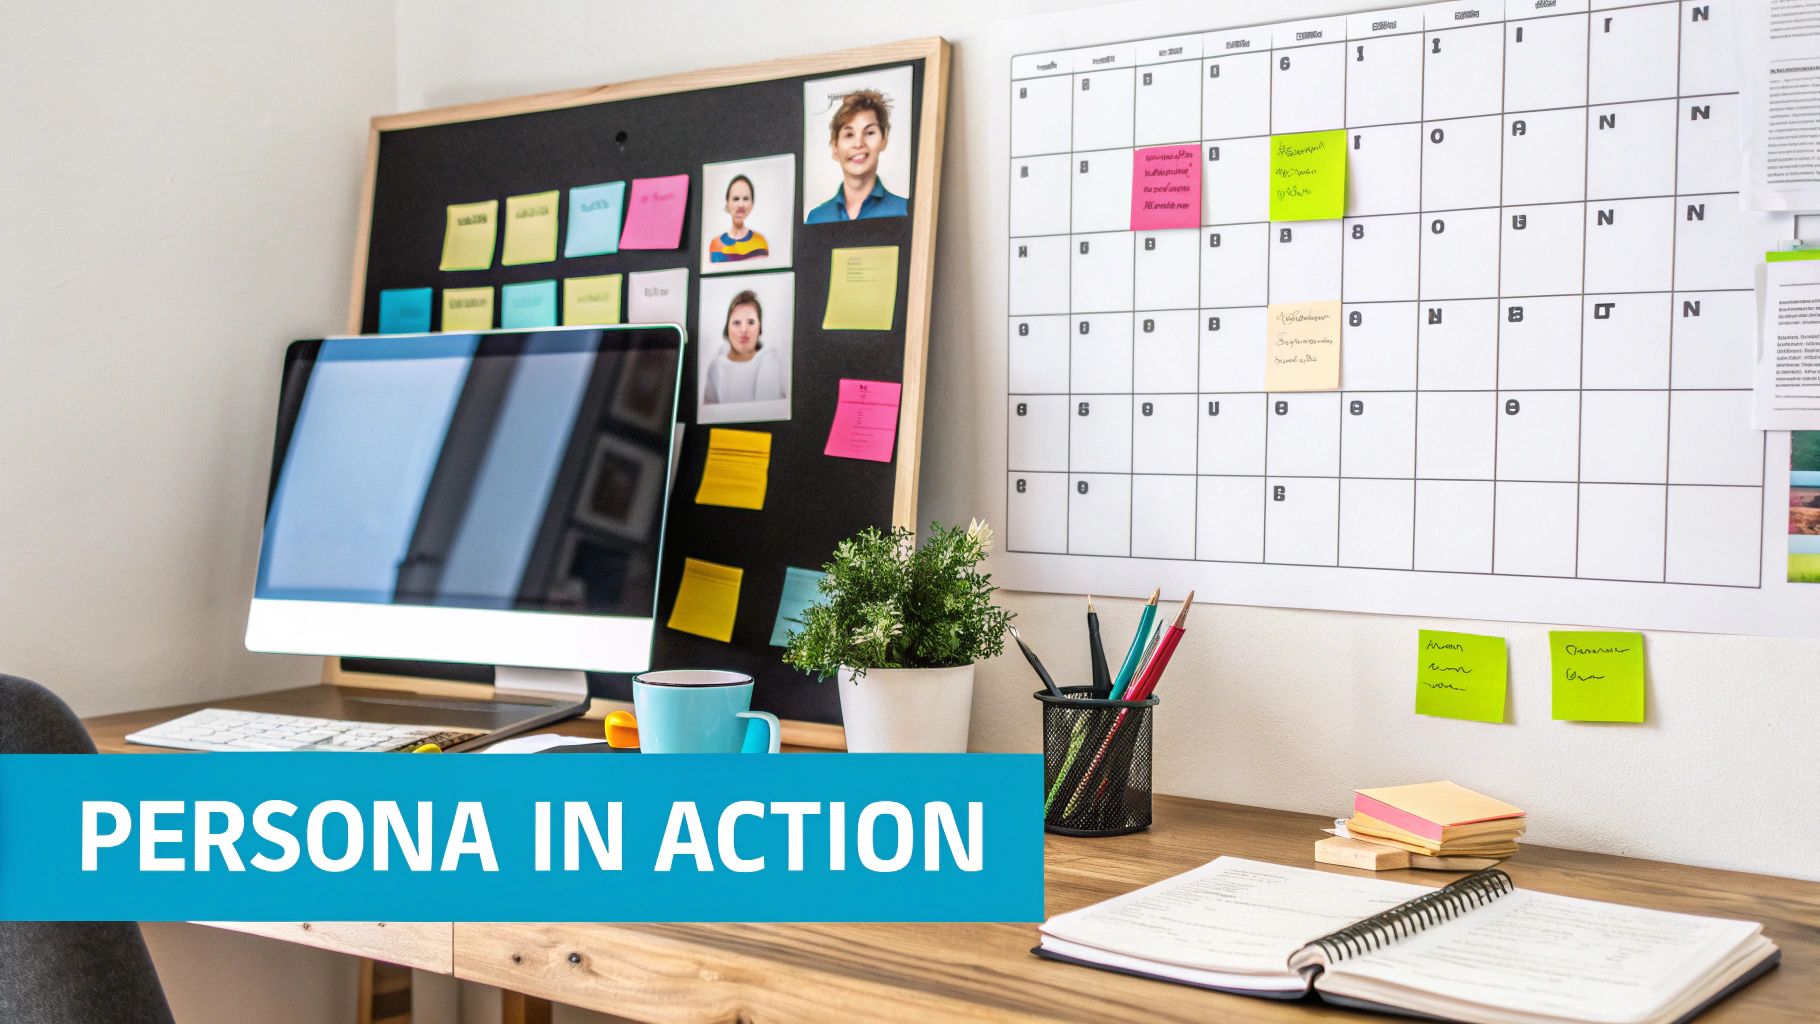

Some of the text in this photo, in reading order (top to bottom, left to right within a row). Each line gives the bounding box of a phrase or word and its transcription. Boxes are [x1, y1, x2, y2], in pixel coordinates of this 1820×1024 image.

[1691, 5, 1710, 23] N
[1690, 104, 1711, 121] N
[1598, 113, 1616, 131] N
[1596, 208, 1615, 226] N
[1686, 203, 1705, 222] N
[1351, 223, 1365, 240] 8
[1682, 300, 1701, 318] N
